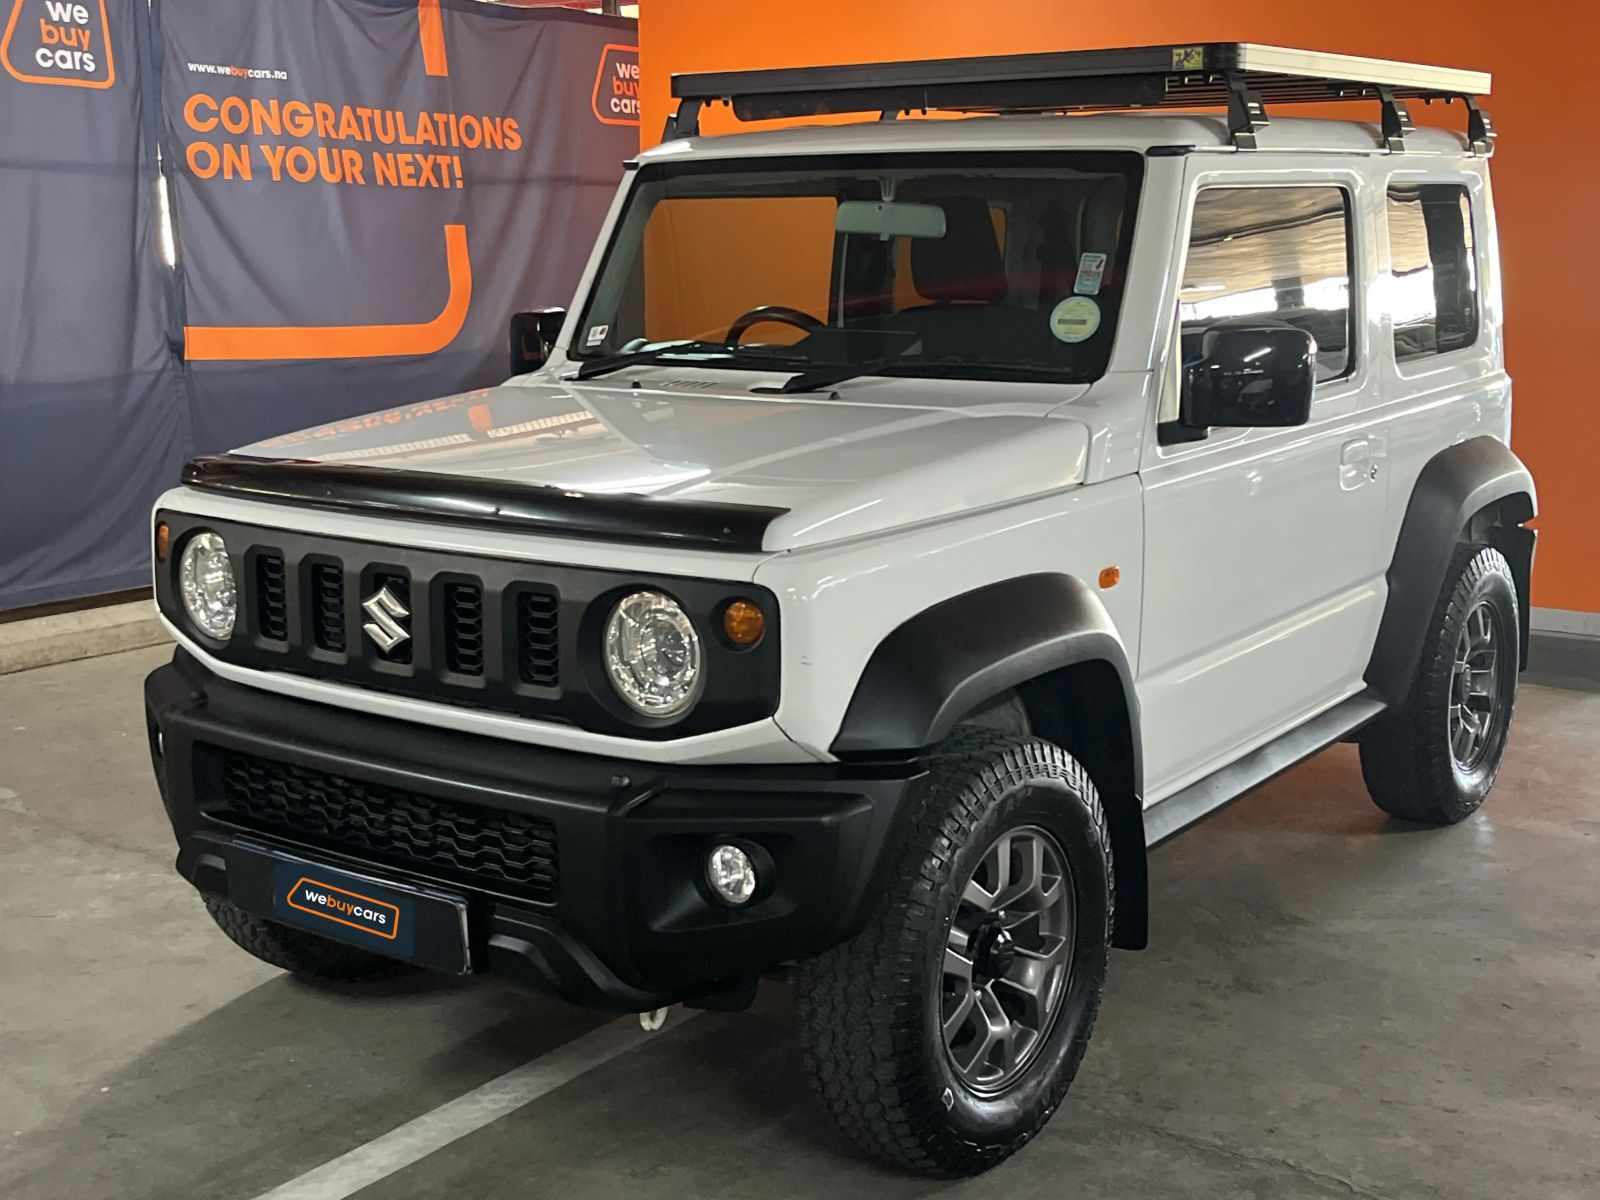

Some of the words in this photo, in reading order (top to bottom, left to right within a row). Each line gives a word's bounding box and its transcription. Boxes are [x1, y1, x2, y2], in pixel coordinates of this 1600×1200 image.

[45, 0, 89, 25] we
[40, 18, 91, 51] buy
[35, 47, 96, 72] cars
[187, 62, 288, 80] www.webuycars.na
[615, 62, 640, 80] we
[183, 93, 522, 151] CONGRATULATIONS
[185, 141, 253, 181] ON
[260, 144, 366, 184] YOUR
[372, 151, 464, 189] NEXT!
